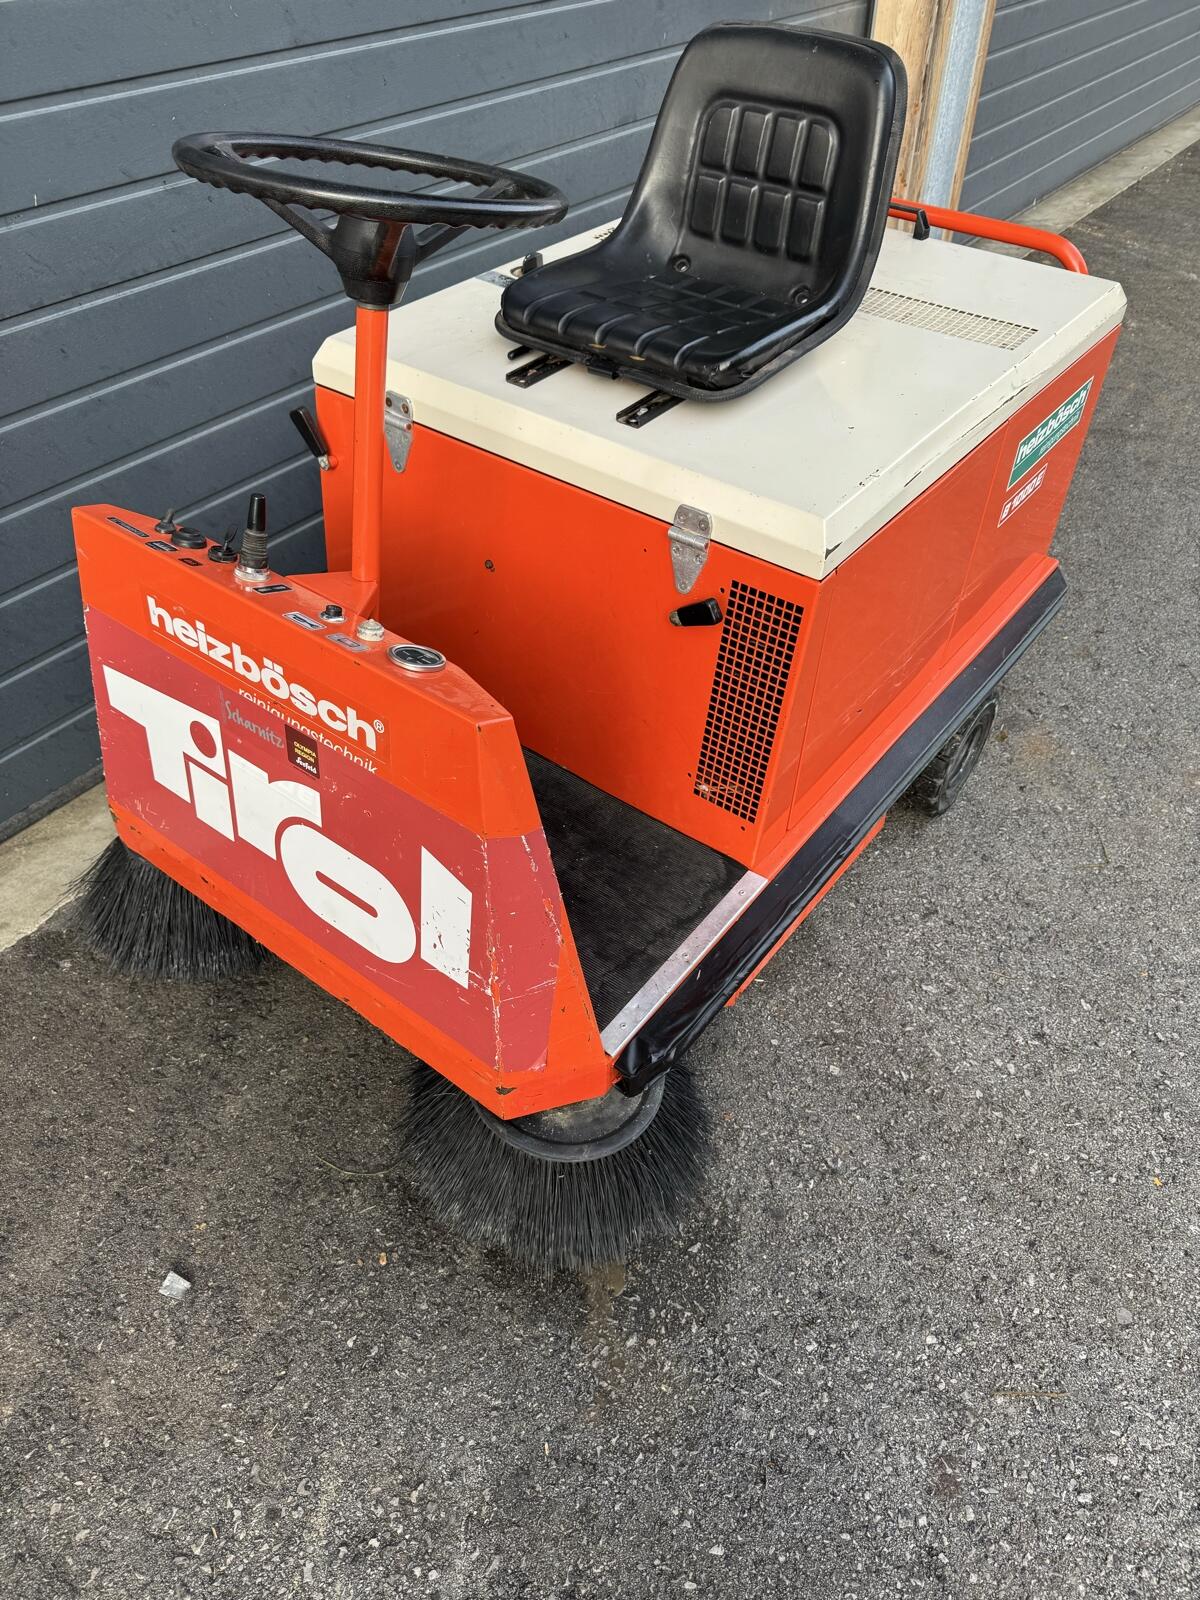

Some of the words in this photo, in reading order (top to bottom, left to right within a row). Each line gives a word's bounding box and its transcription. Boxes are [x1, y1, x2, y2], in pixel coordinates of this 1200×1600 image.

[1016, 390, 1087, 463] heizbösch
[294, 741, 316, 757] OLYMPIA
[295, 747, 315, 763] REGION
[296, 757, 317, 774] Seefeld
[102, 665, 472, 989] Tirol
